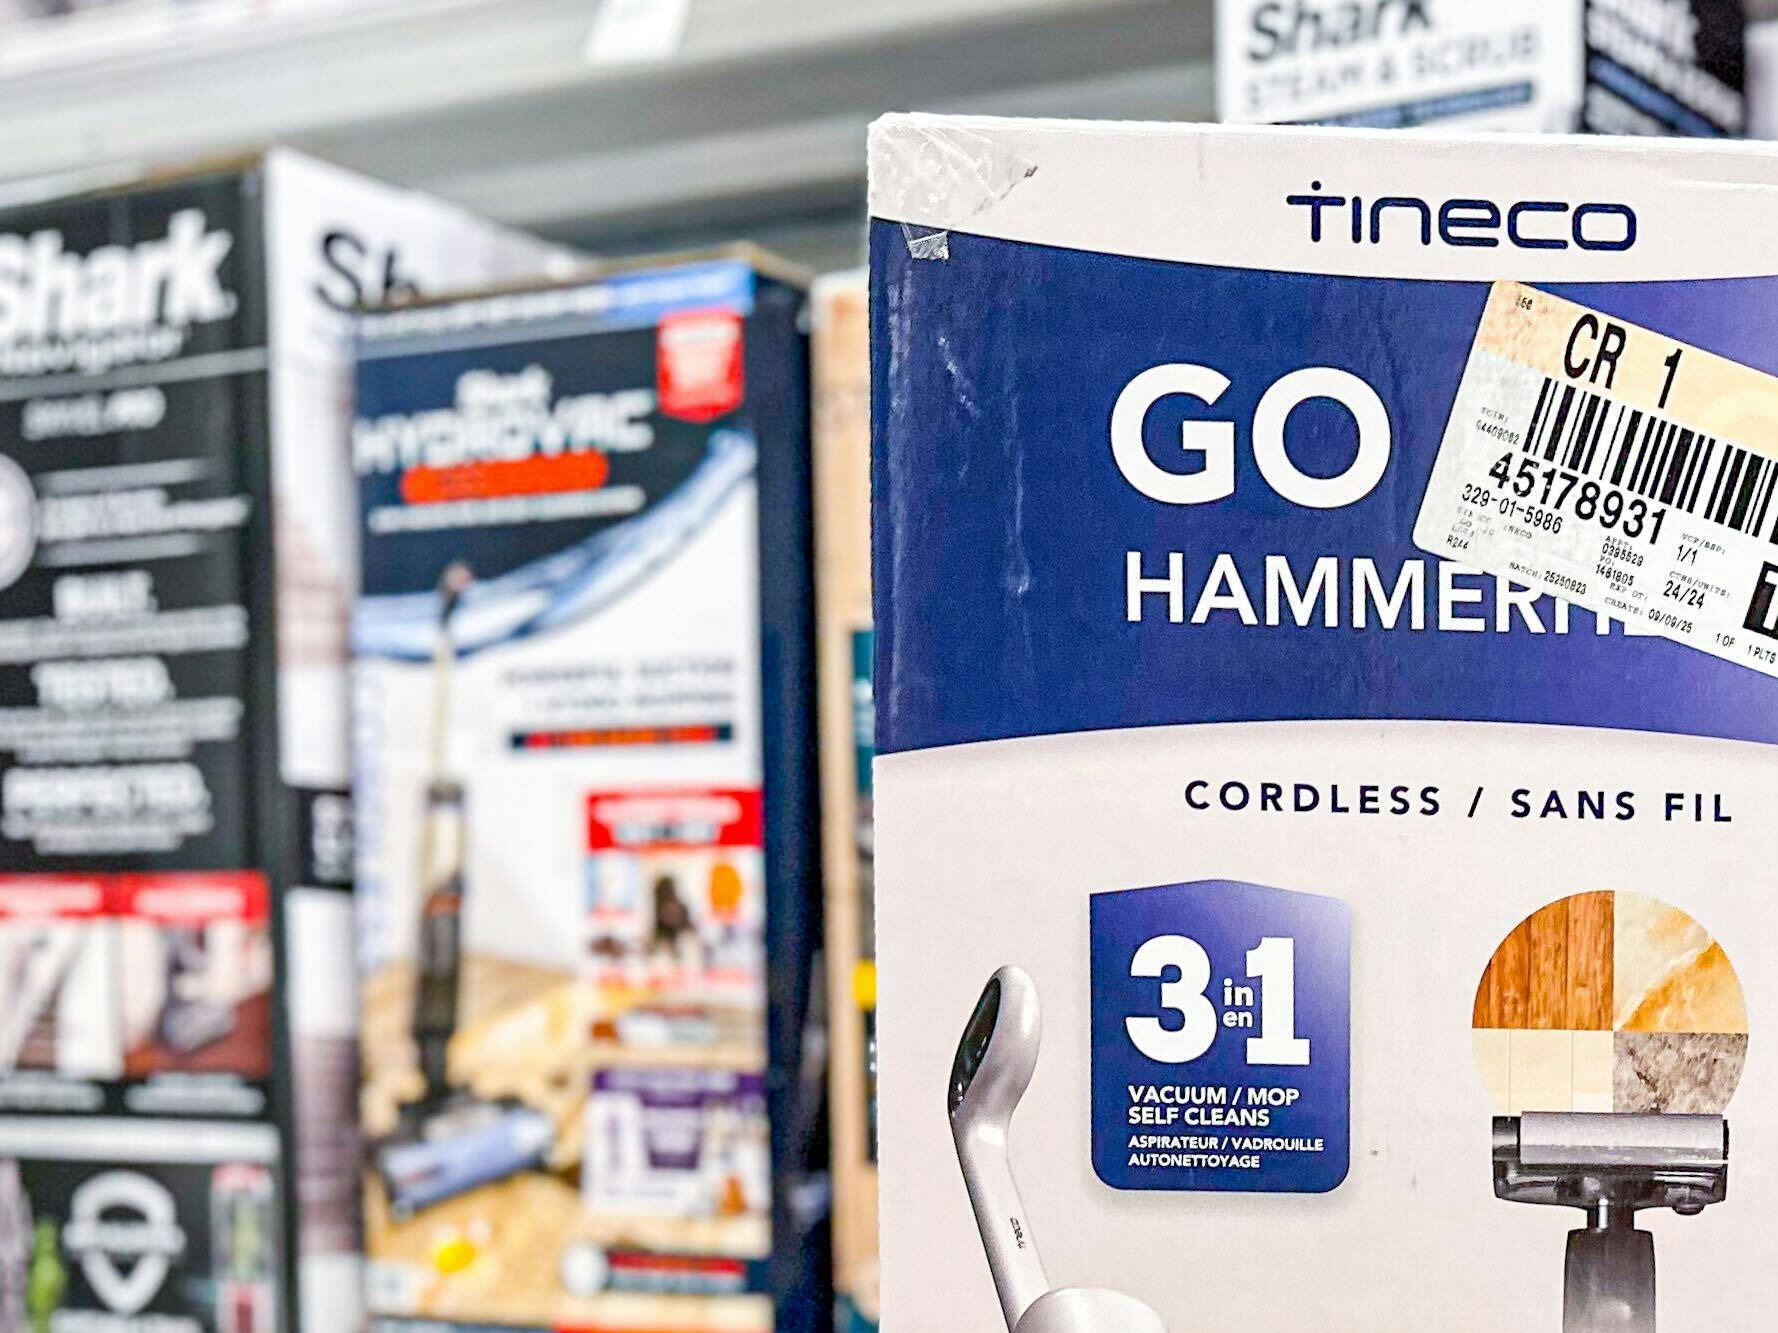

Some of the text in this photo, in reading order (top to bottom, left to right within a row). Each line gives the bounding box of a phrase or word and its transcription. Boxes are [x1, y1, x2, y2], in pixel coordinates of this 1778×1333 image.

[1563, 313, 1627, 390] CR
[1657, 347, 1683, 409] 1
[1110, 364, 1392, 509] GO
[1461, 482, 1564, 534] 329-01-5986
[1488, 451, 1667, 546] 45178931
[1675, 544, 1699, 567] 1/1
[1662, 579, 1705, 610] 24/24
[1184, 779, 1733, 823] CORDLESS / SANS FIL
[1125, 933, 1311, 1066] 3 in 1
[1222, 1011, 1254, 1028] en
[1127, 1085, 1301, 1106] VACUUM / MOP
[1128, 1106, 1270, 1127] SELF CLEANS
[1127, 1135, 1219, 1150] ASPIRATEUR
[1231, 1136, 1324, 1152] VADROUILLE
[1127, 1154, 1261, 1169] AUTONETTOYAGE
